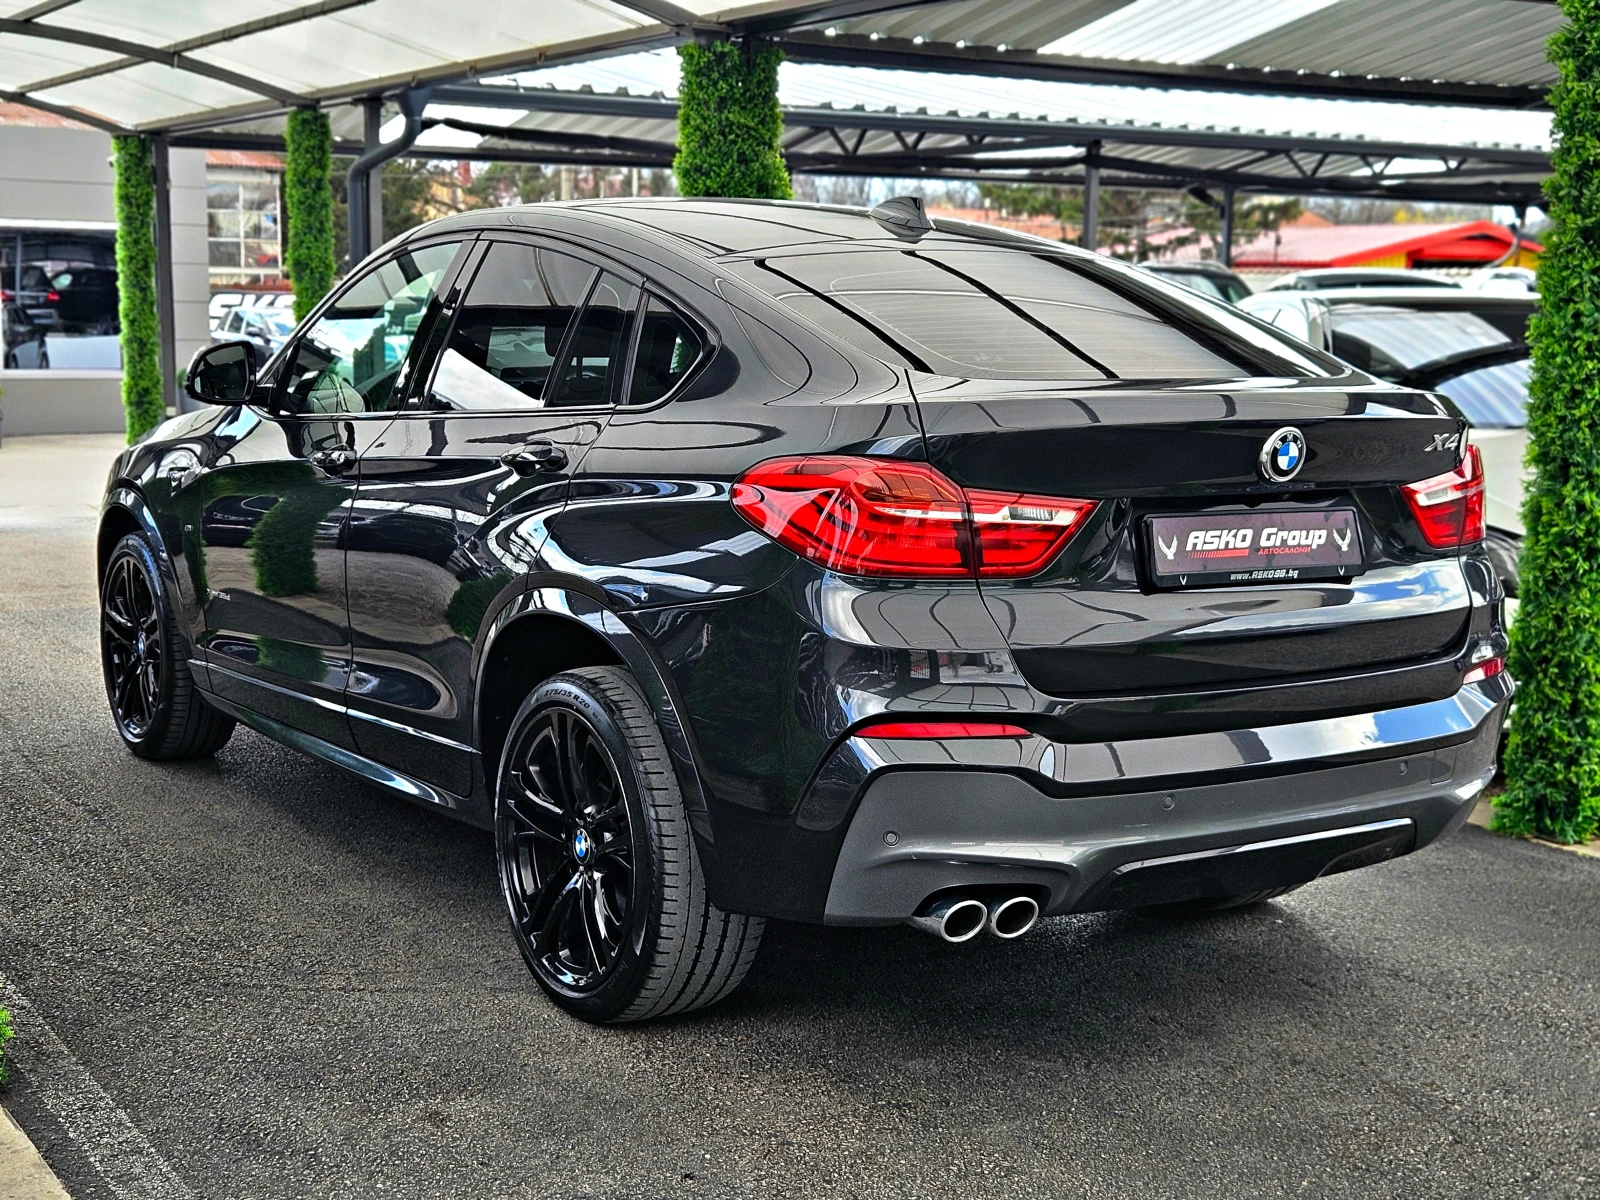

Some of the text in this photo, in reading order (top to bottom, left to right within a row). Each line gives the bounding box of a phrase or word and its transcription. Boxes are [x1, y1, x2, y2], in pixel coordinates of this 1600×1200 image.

[1274, 433, 1302, 449] BMW
[1423, 433, 1460, 452] X4
[1185, 527, 1328, 551] ASKO Group
[1258, 546, 1311, 556] АВТОСАЛОНИ
[544, 688, 591, 709] 275/35 R20
